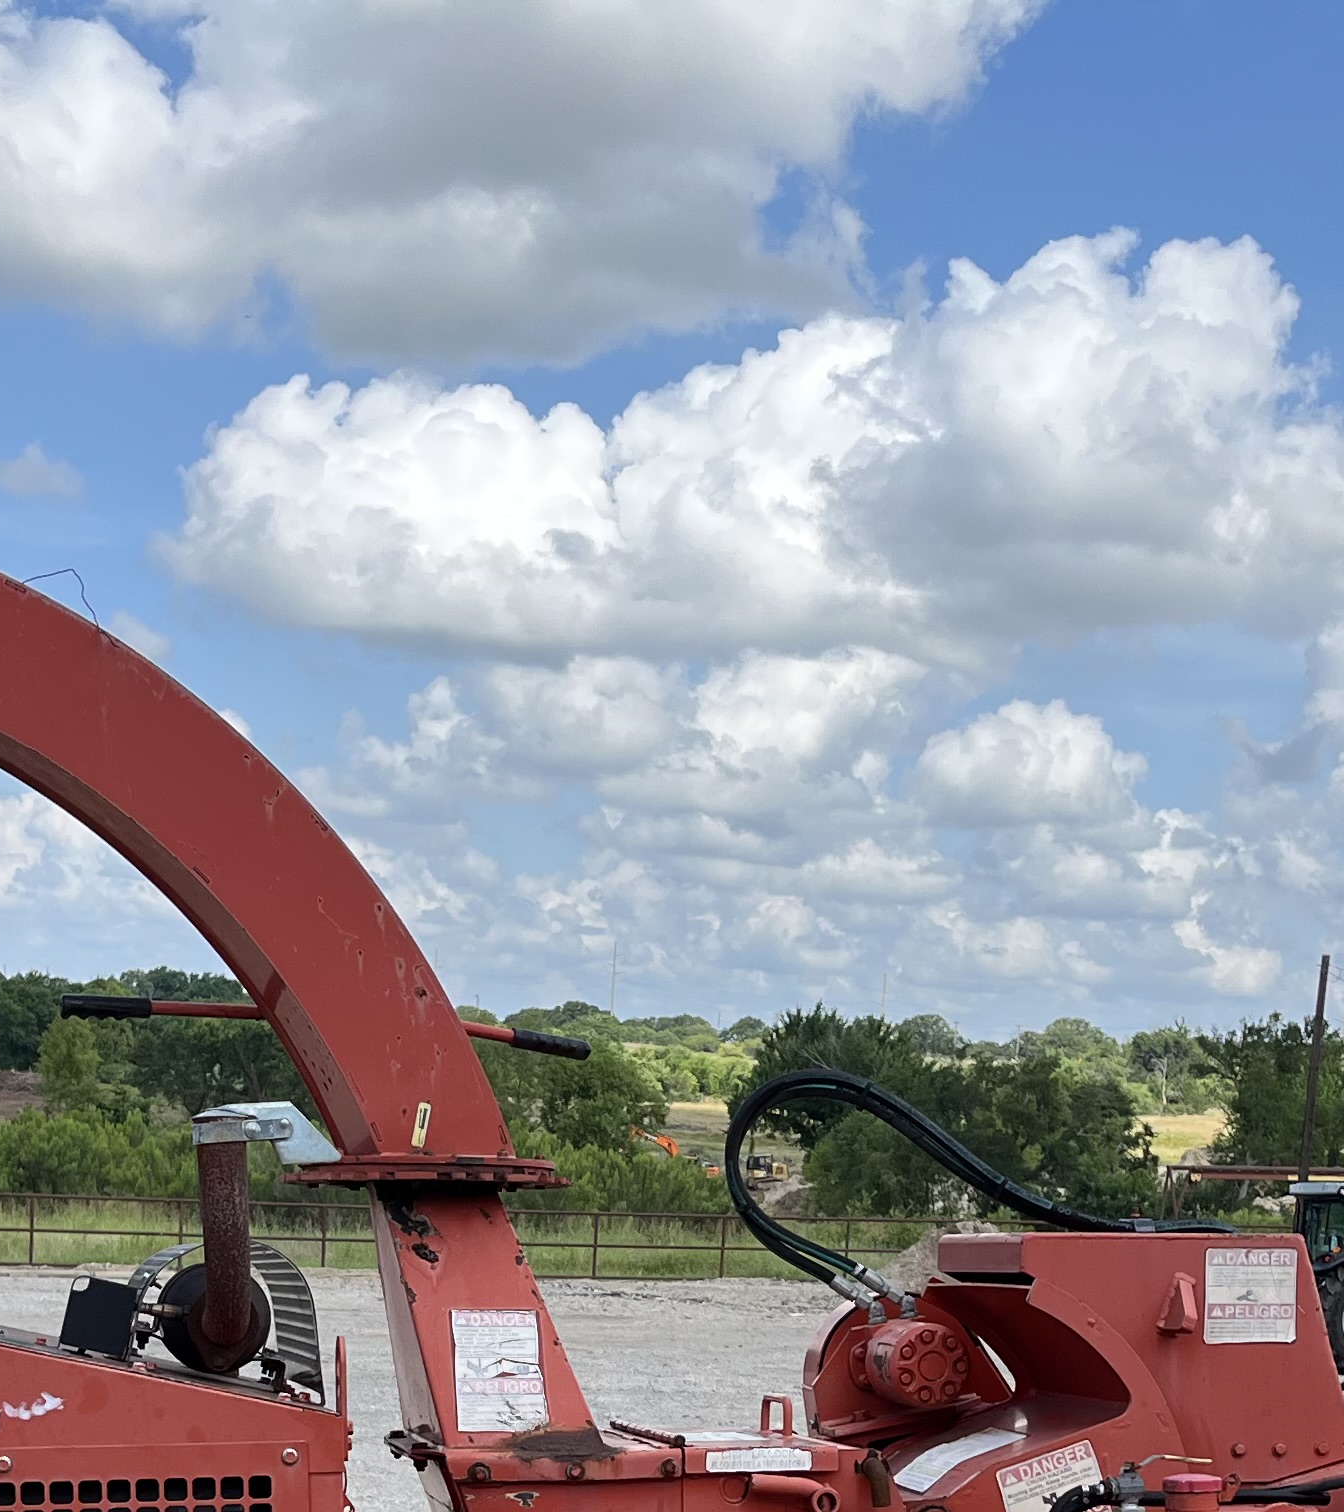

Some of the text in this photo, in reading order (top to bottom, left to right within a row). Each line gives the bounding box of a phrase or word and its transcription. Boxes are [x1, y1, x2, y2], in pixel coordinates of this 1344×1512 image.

[1225, 1252, 1291, 1266] DANGER
[1225, 1305, 1292, 1319] PELIGRO
[470, 1312, 536, 1327] DANGER
[1019, 1444, 1088, 1480] DANGER
